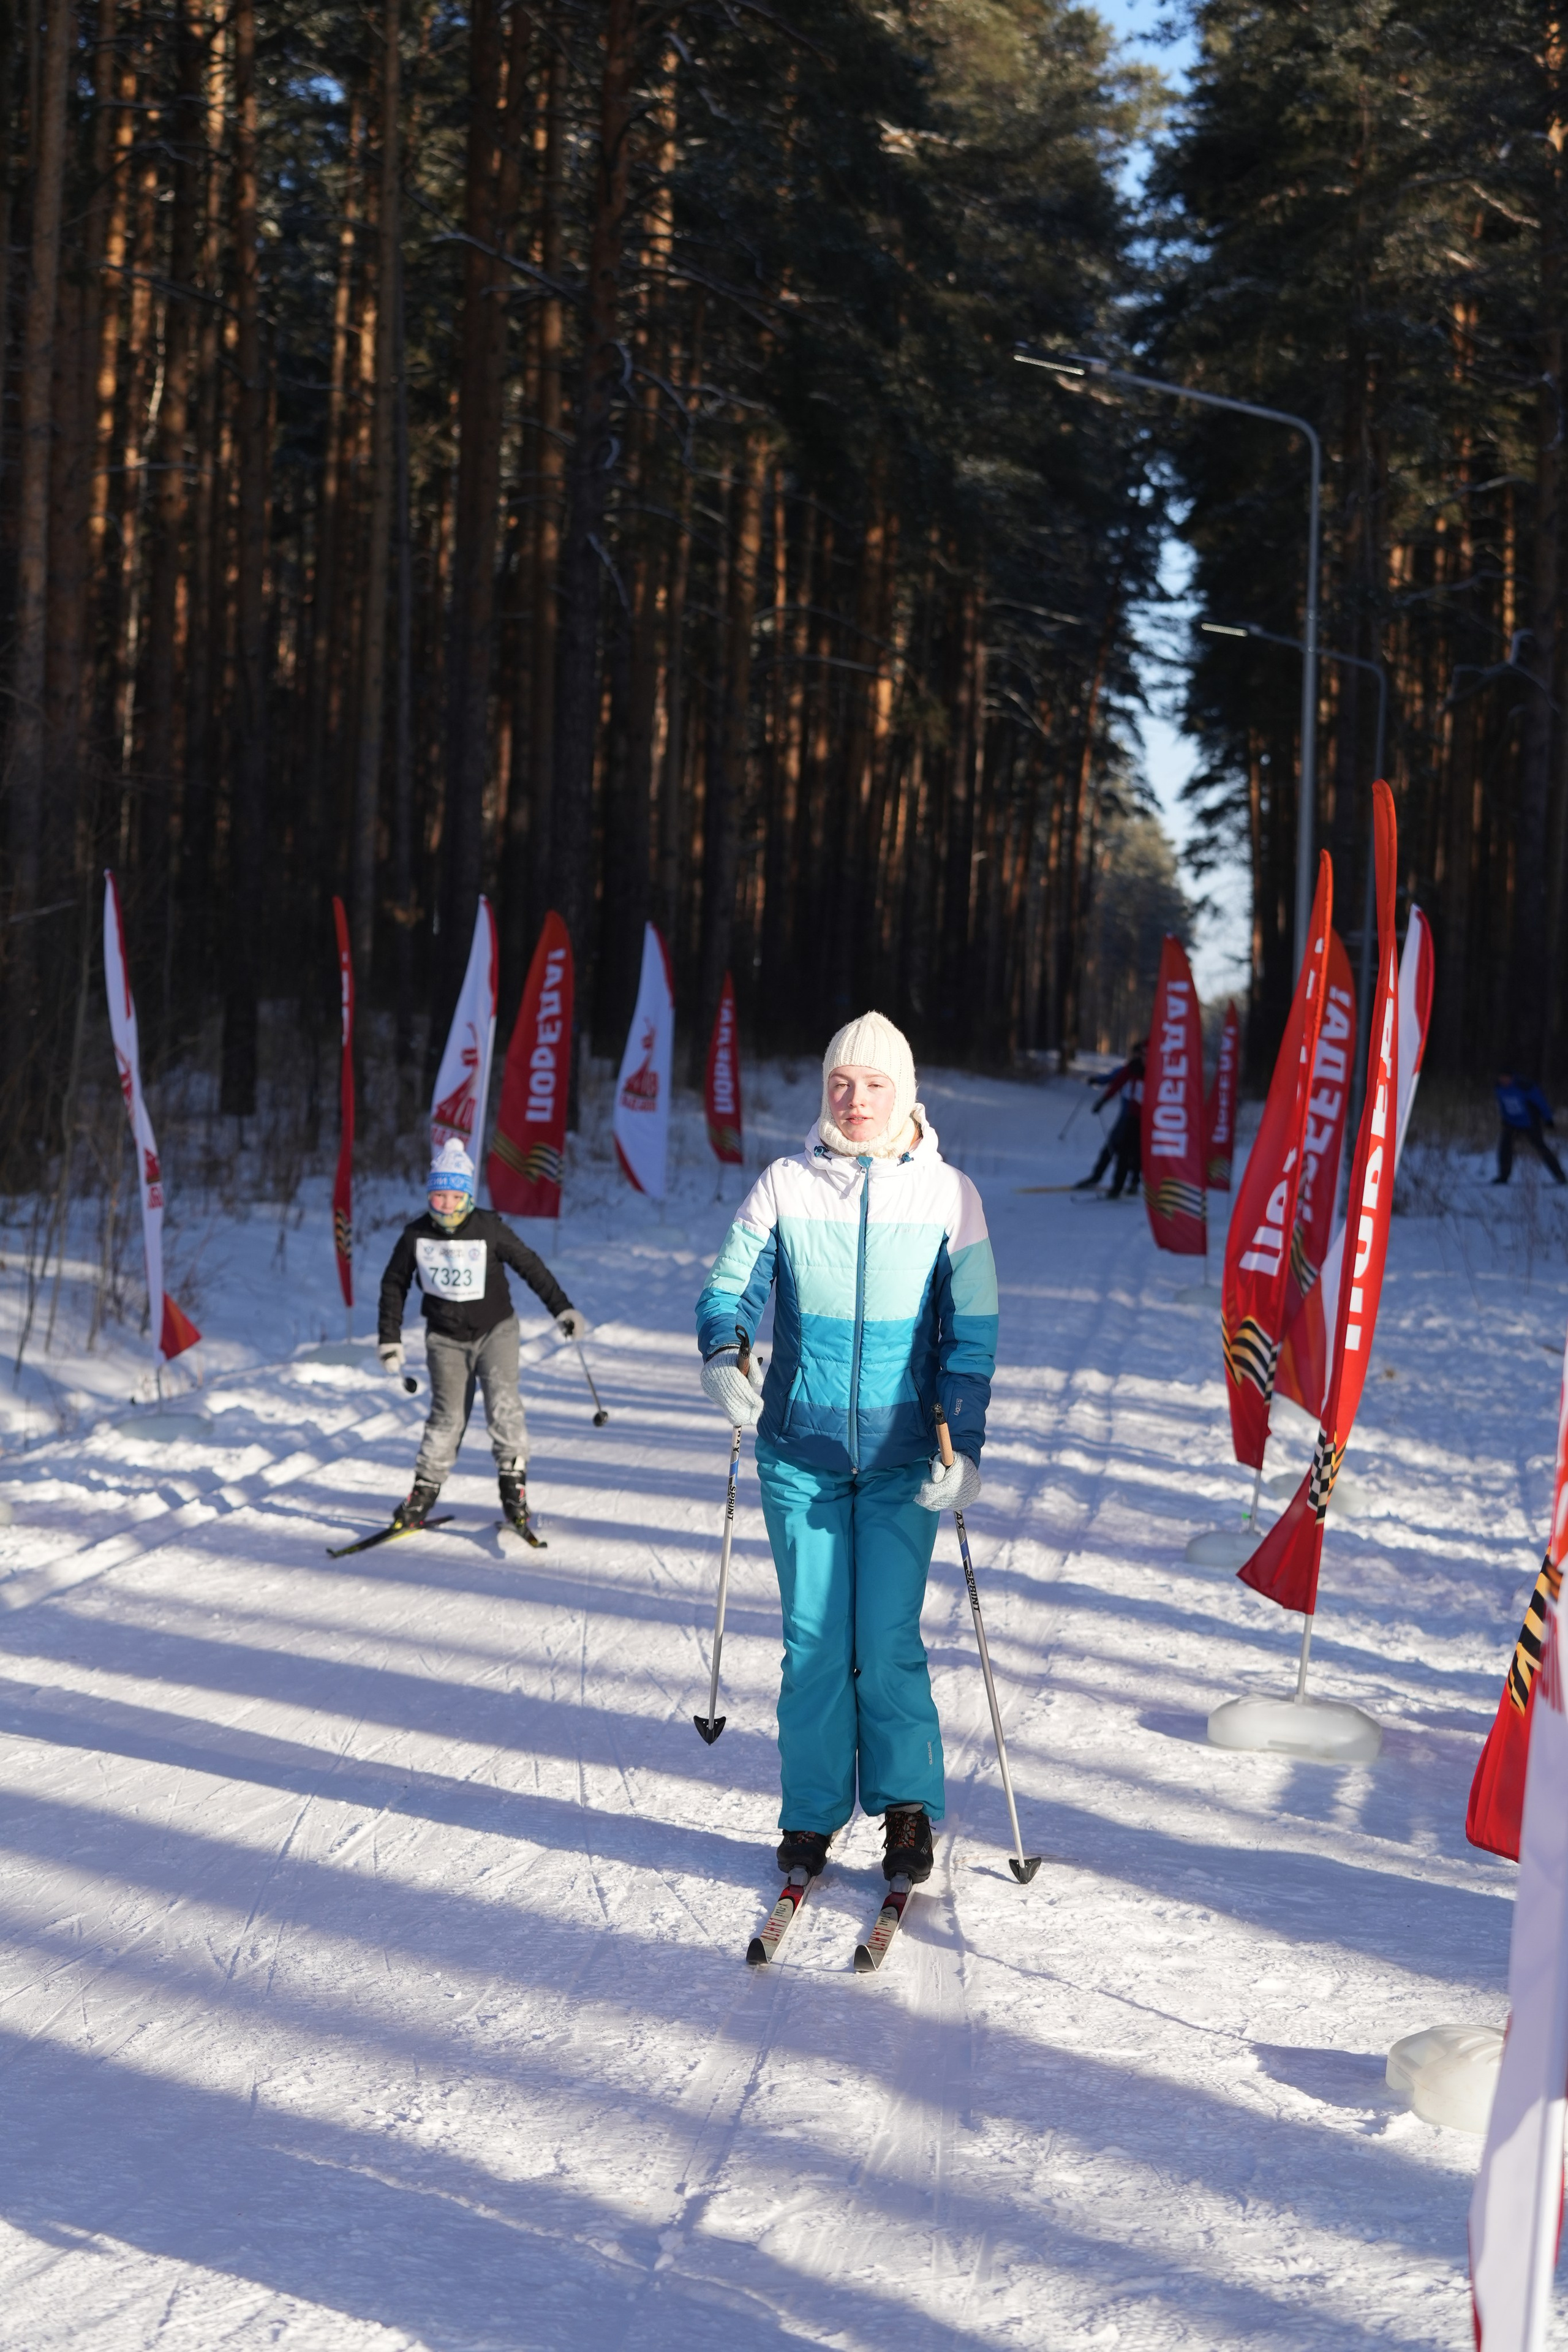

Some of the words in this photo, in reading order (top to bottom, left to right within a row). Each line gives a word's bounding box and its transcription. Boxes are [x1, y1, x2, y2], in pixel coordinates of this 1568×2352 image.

[429, 1267, 472, 1286] 7323
[727, 1485, 736, 1521] SPRINT
[967, 1569, 980, 1613] SPRINT
